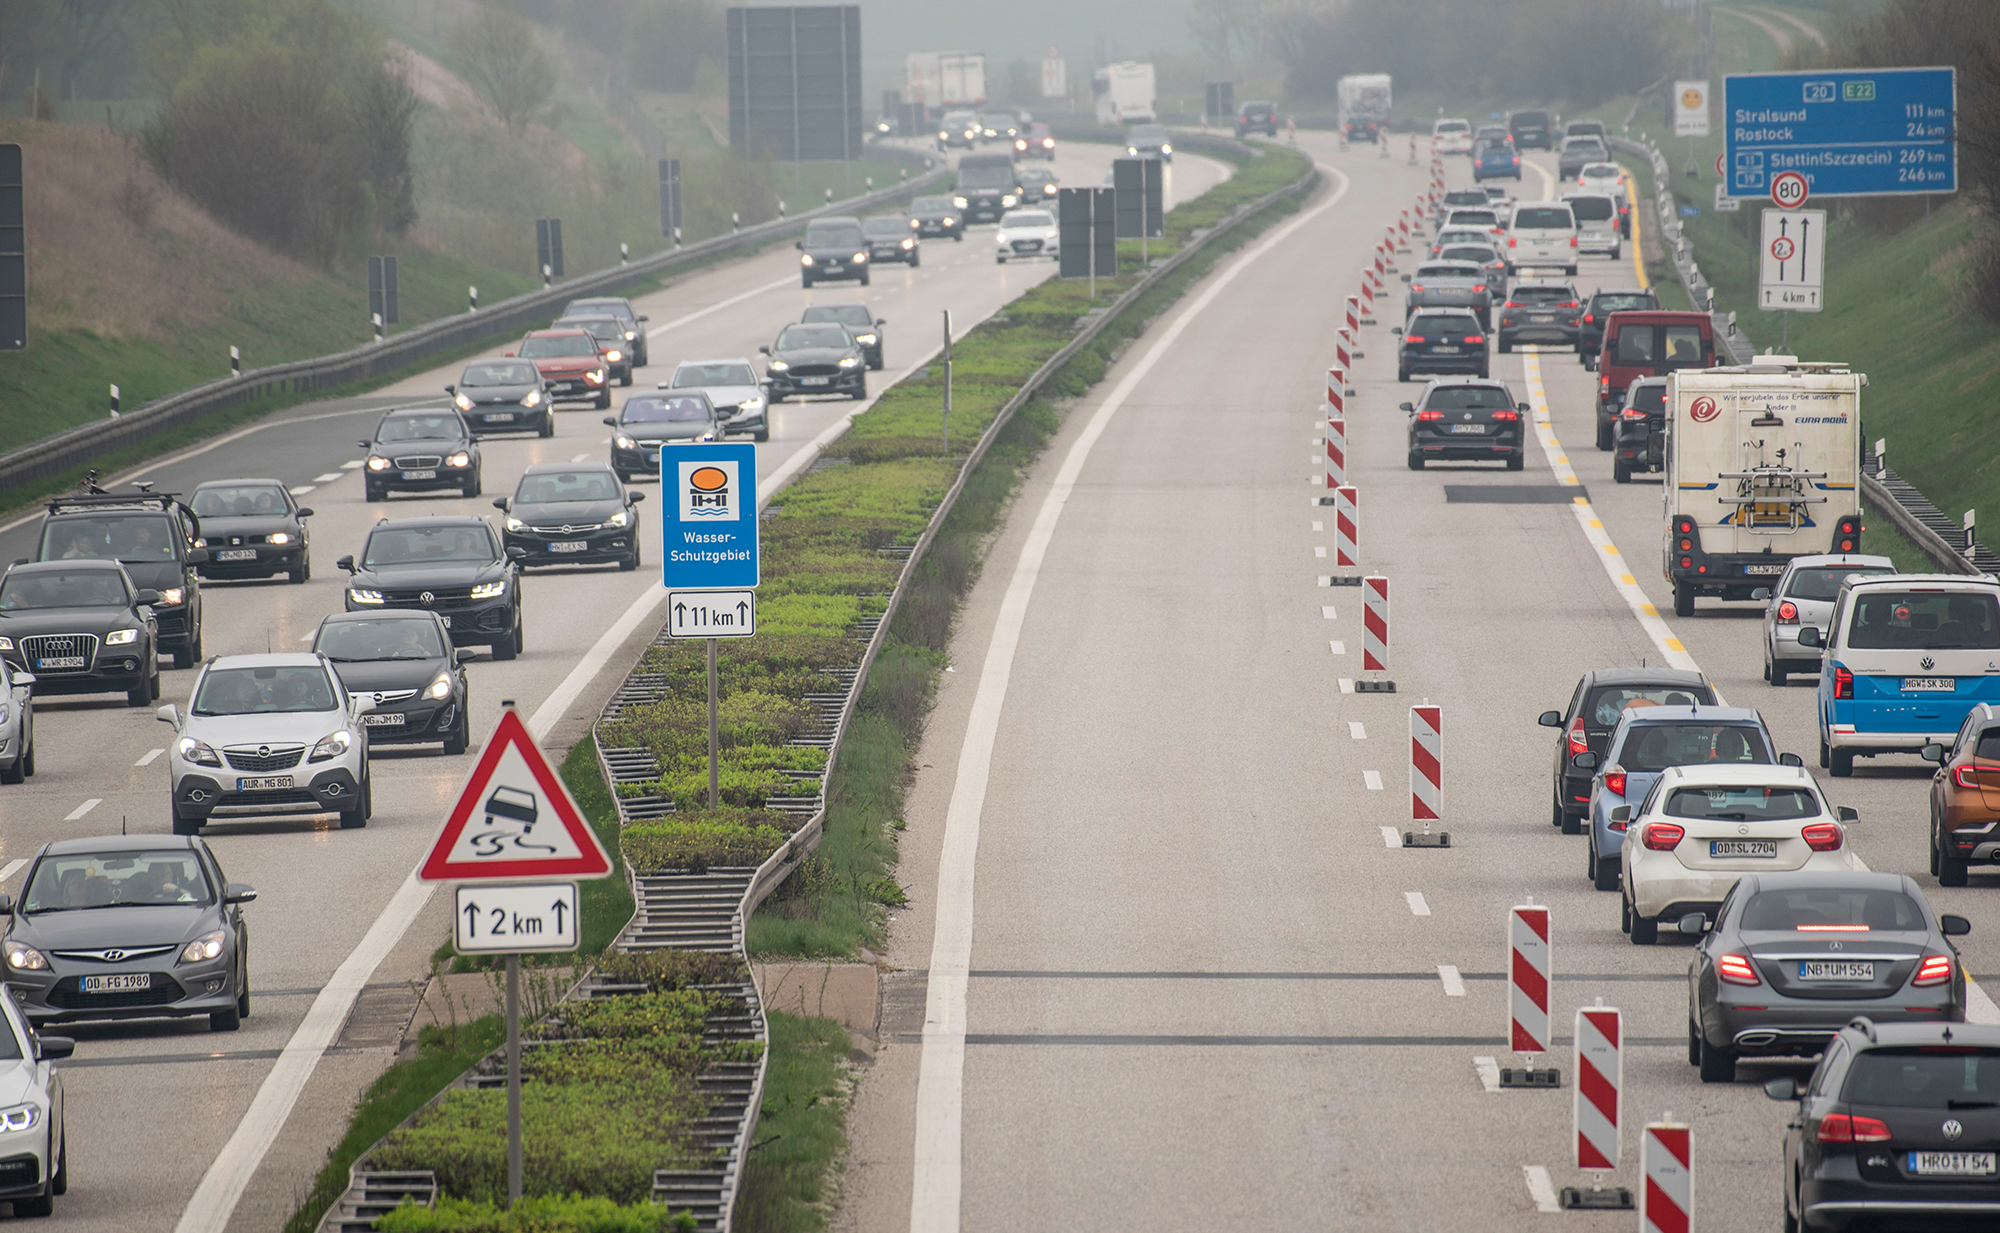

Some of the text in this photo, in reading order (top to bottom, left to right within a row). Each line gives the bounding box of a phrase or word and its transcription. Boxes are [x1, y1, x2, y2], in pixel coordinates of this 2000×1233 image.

[1811, 86, 1828, 98] 20
[1846, 84, 1872, 97] E 22
[1735, 104, 1945, 124] Stralsund 111 km
[1735, 123, 1945, 142] Rostock 24 km
[1770, 149, 1892, 168] Stettin(Szczecin)
[1899, 149, 1924, 164] 269
[1928, 152, 1945, 162] km
[1899, 168, 1924, 182] 246
[1928, 170, 1945, 180] km
[1780, 182, 1800, 198] 80
[1792, 392, 1809, 400] Erbe
[683, 532, 737, 544] Wasser-
[670, 549, 750, 564] Schutzgebiet
[692, 606, 734, 626] 11 km
[64, 658, 83, 666] 1904
[1906, 678, 1954, 688] HGW SK 300
[380, 716, 392, 724] JM
[392, 714, 404, 724] 99
[243, 778, 292, 789] AUR MG 801
[1717, 842, 1774, 854] OD SL 2704
[491, 908, 542, 935] 2 km
[1807, 964, 1872, 976] NB UM 554
[87, 976, 148, 989] OD FG 1989
[1922, 1153, 1990, 1170] HRO T 54
